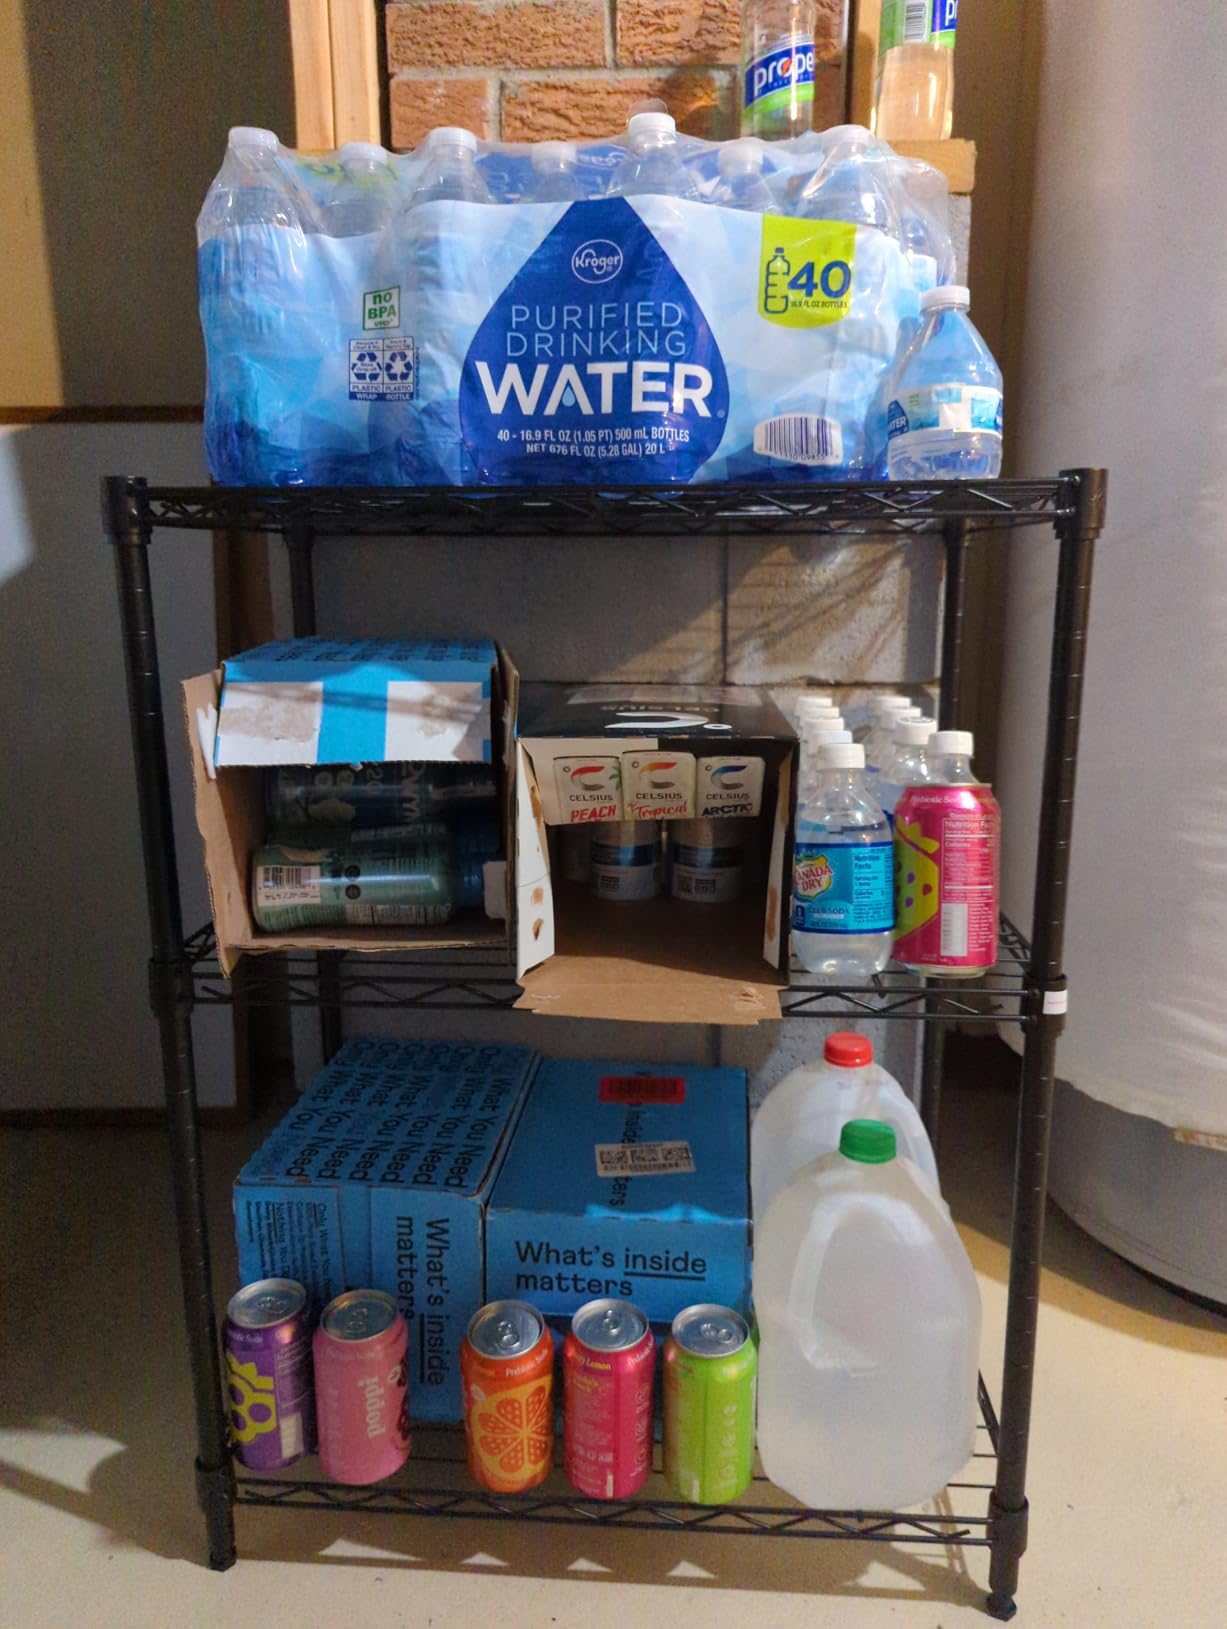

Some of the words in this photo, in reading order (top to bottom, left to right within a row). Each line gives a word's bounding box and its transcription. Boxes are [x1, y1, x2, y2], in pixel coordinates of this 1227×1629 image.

[754, 52, 814, 96] prope
[575, 248, 620, 275] Kroger
[787, 260, 851, 298] 40
[368, 305, 396, 320] BPA
[511, 302, 683, 331] PURIFIED
[507, 329, 686, 357] DRINKING
[475, 360, 713, 418] WATER
[890, 415, 906, 428] TER
[497, 430, 510, 442] 40
[520, 430, 541, 441] 16.9
[544, 430, 556, 442] FL
[558, 430, 571, 442] OZ
[599, 429, 613, 443] PT)
[615, 428, 631, 440] 500
[634, 428, 648, 440] mL
[651, 427, 690, 443] BOTTLES
[526, 443, 547, 453] NET
[570, 444, 581, 456] FL
[584, 445, 596, 457] OZ
[621, 443, 643, 457] GAL)
[645, 442, 657, 455] 20
[659, 442, 665, 454] L
[569, 794, 614, 802] CELSIUS
[633, 800, 688, 818] Tropical
[636, 791, 682, 801] CELSIUS
[706, 792, 750, 801] CELSIUS
[571, 804, 617, 821] PEACH
[702, 803, 753, 817] ARCTIC
[802, 877, 823, 891] DRY
[289, 1106, 329, 1131] You
[318, 1110, 355, 1133] You
[377, 1112, 413, 1136] You
[408, 1113, 441, 1137] You
[437, 1114, 471, 1138] You
[466, 1115, 499, 1140] You
[285, 1136, 337, 1177] Need
[316, 1138, 366, 1179] Need
[348, 1139, 395, 1181] Need
[380, 1141, 425, 1184] Need
[412, 1142, 456, 1185] Need
[444, 1143, 486, 1188] Need
[609, 1176, 633, 1206] ters
[397, 1215, 418, 1320] matters
[426, 1218, 450, 1307] What's
[515, 1240, 616, 1267] What's
[623, 1248, 708, 1275] inside
[515, 1273, 633, 1297] matters
[427, 1314, 450, 1386] inside
[358, 1376, 385, 1439] poppi
